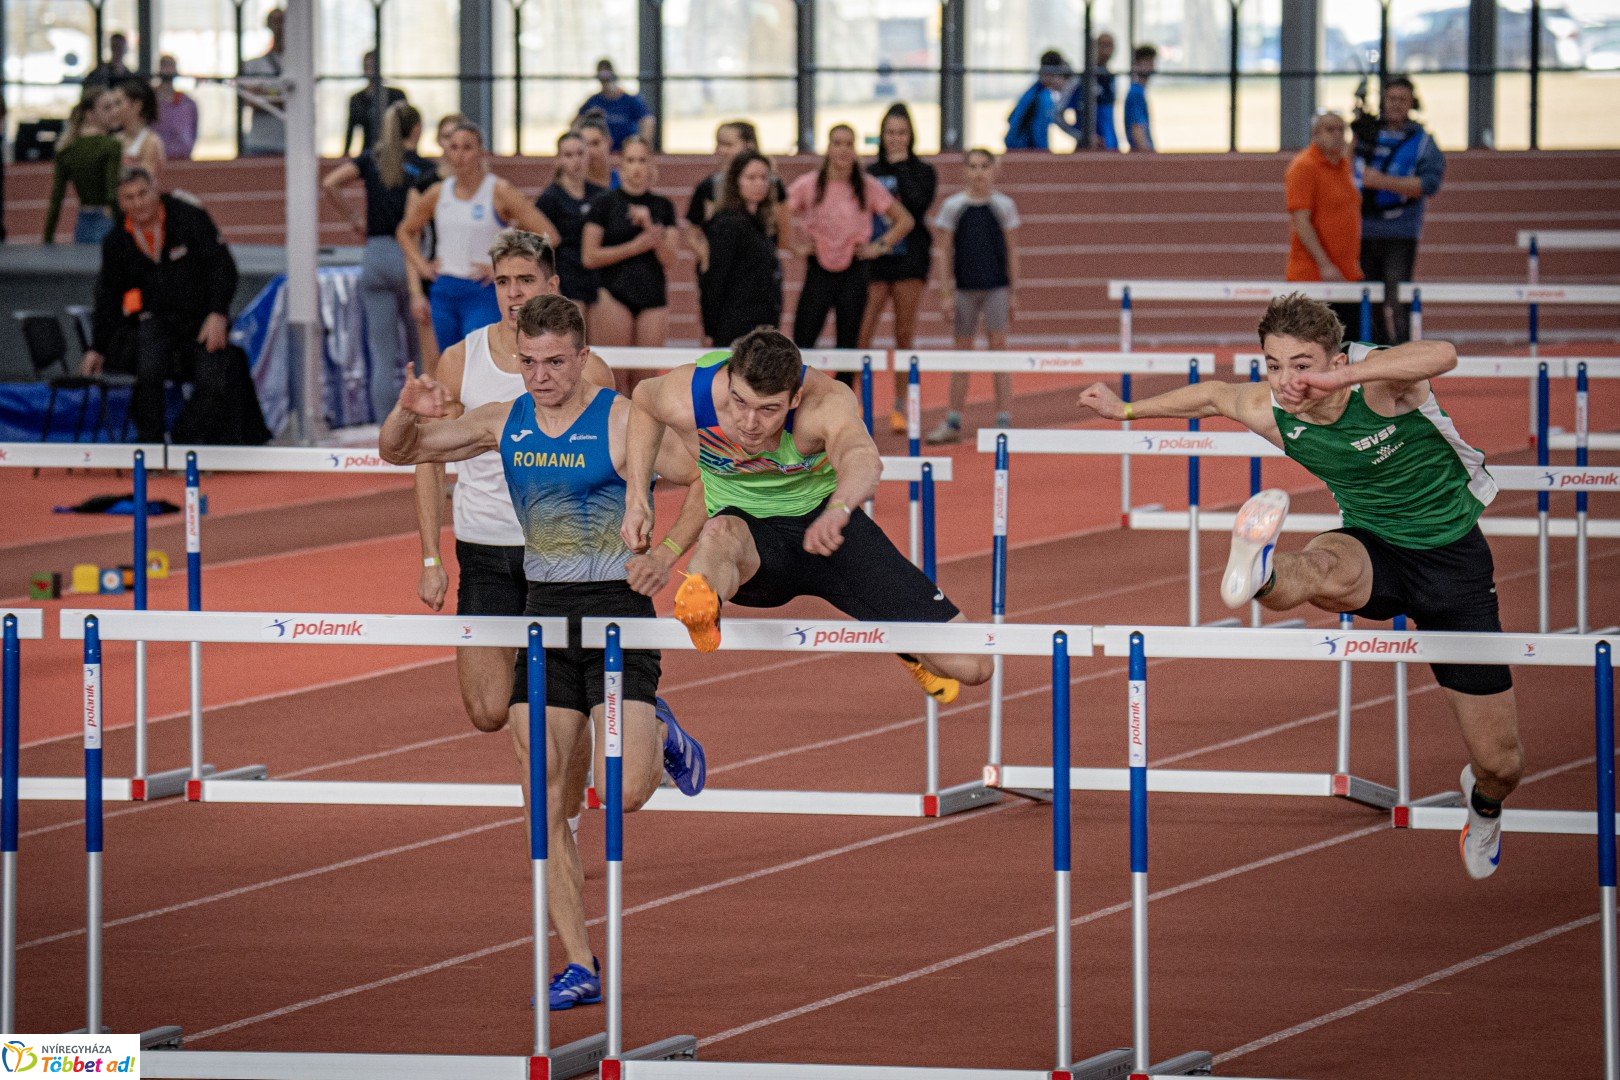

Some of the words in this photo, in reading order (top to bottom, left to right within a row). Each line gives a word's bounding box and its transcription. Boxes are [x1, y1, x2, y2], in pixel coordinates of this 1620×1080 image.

[1158, 436, 1214, 451] polanik
[513, 451, 586, 469] ROMANIA
[1560, 472, 1619, 487] polanik
[293, 620, 363, 639] polanik
[813, 627, 886, 647] polanik
[1344, 636, 1419, 657] polanik
[85, 683, 97, 728] polanik
[607, 692, 618, 736] polanik
[1130, 701, 1143, 746] polanik
